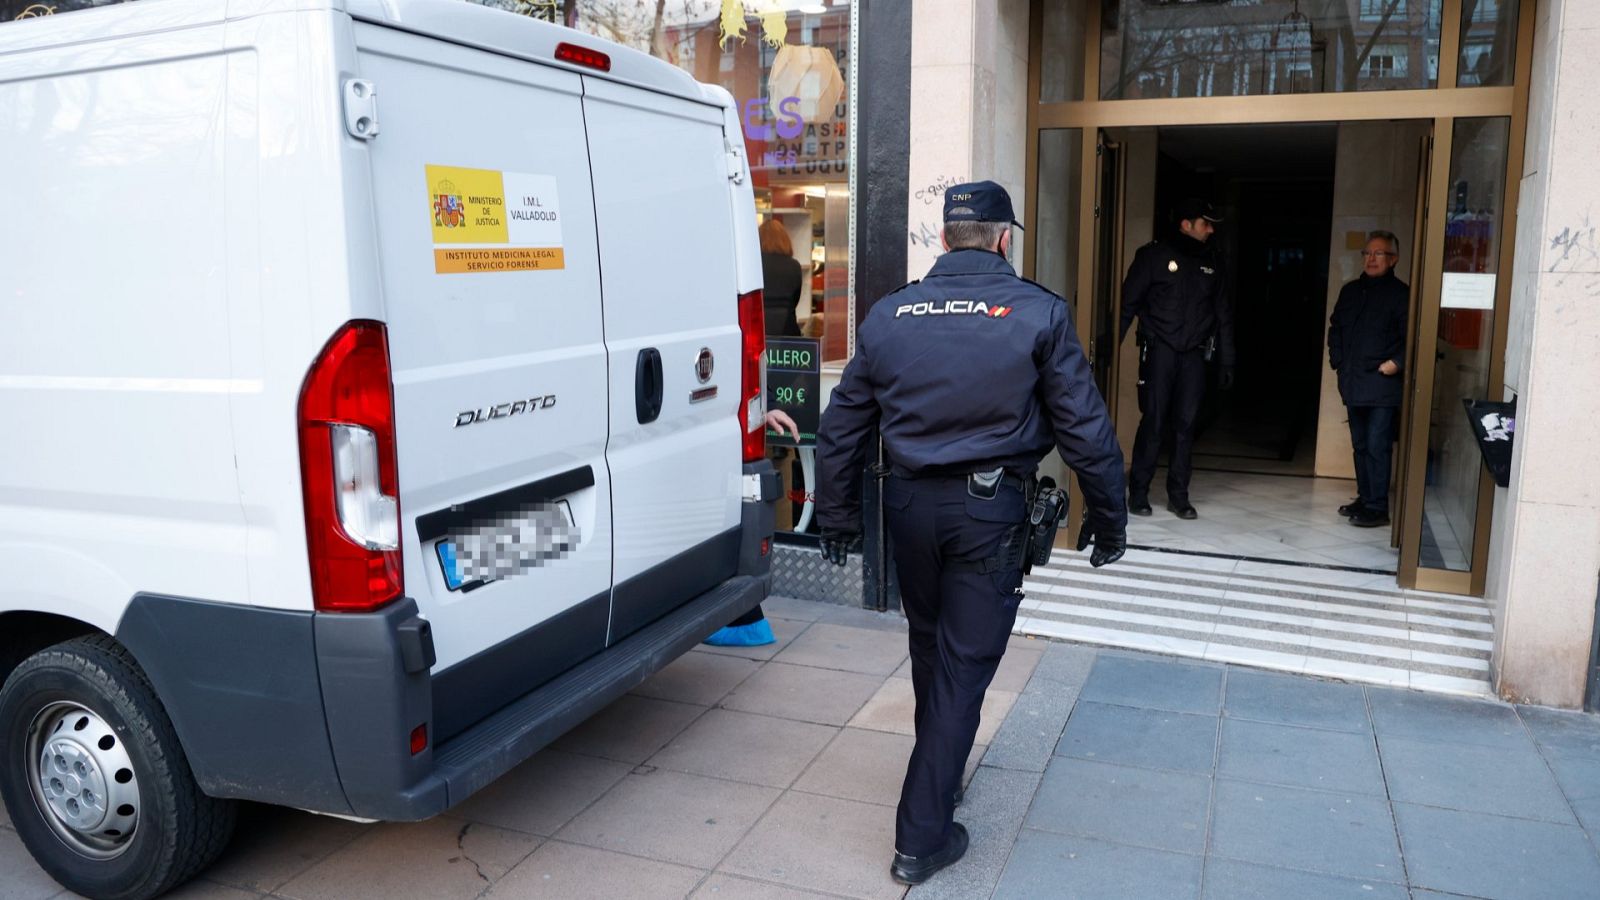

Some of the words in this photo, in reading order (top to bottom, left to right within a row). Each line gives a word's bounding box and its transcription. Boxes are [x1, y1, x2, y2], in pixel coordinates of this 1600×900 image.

[468, 196, 502, 206] MINISTERIO
[523, 197, 543, 207] I.M.L.
[952, 193, 972, 202] CNP
[482, 207, 491, 216] DE
[510, 210, 557, 222] VALLADOLID
[475, 218, 500, 227] JUSTICIA
[445, 251, 490, 260] INSTITUTO
[492, 251, 531, 260] MEDICINA
[532, 250, 555, 259] LEGAL
[466, 261, 504, 271] SERVICIO
[506, 260, 539, 269] FORENSE
[895, 301, 989, 318] POLICIA
[453, 394, 556, 428] DUCATO
